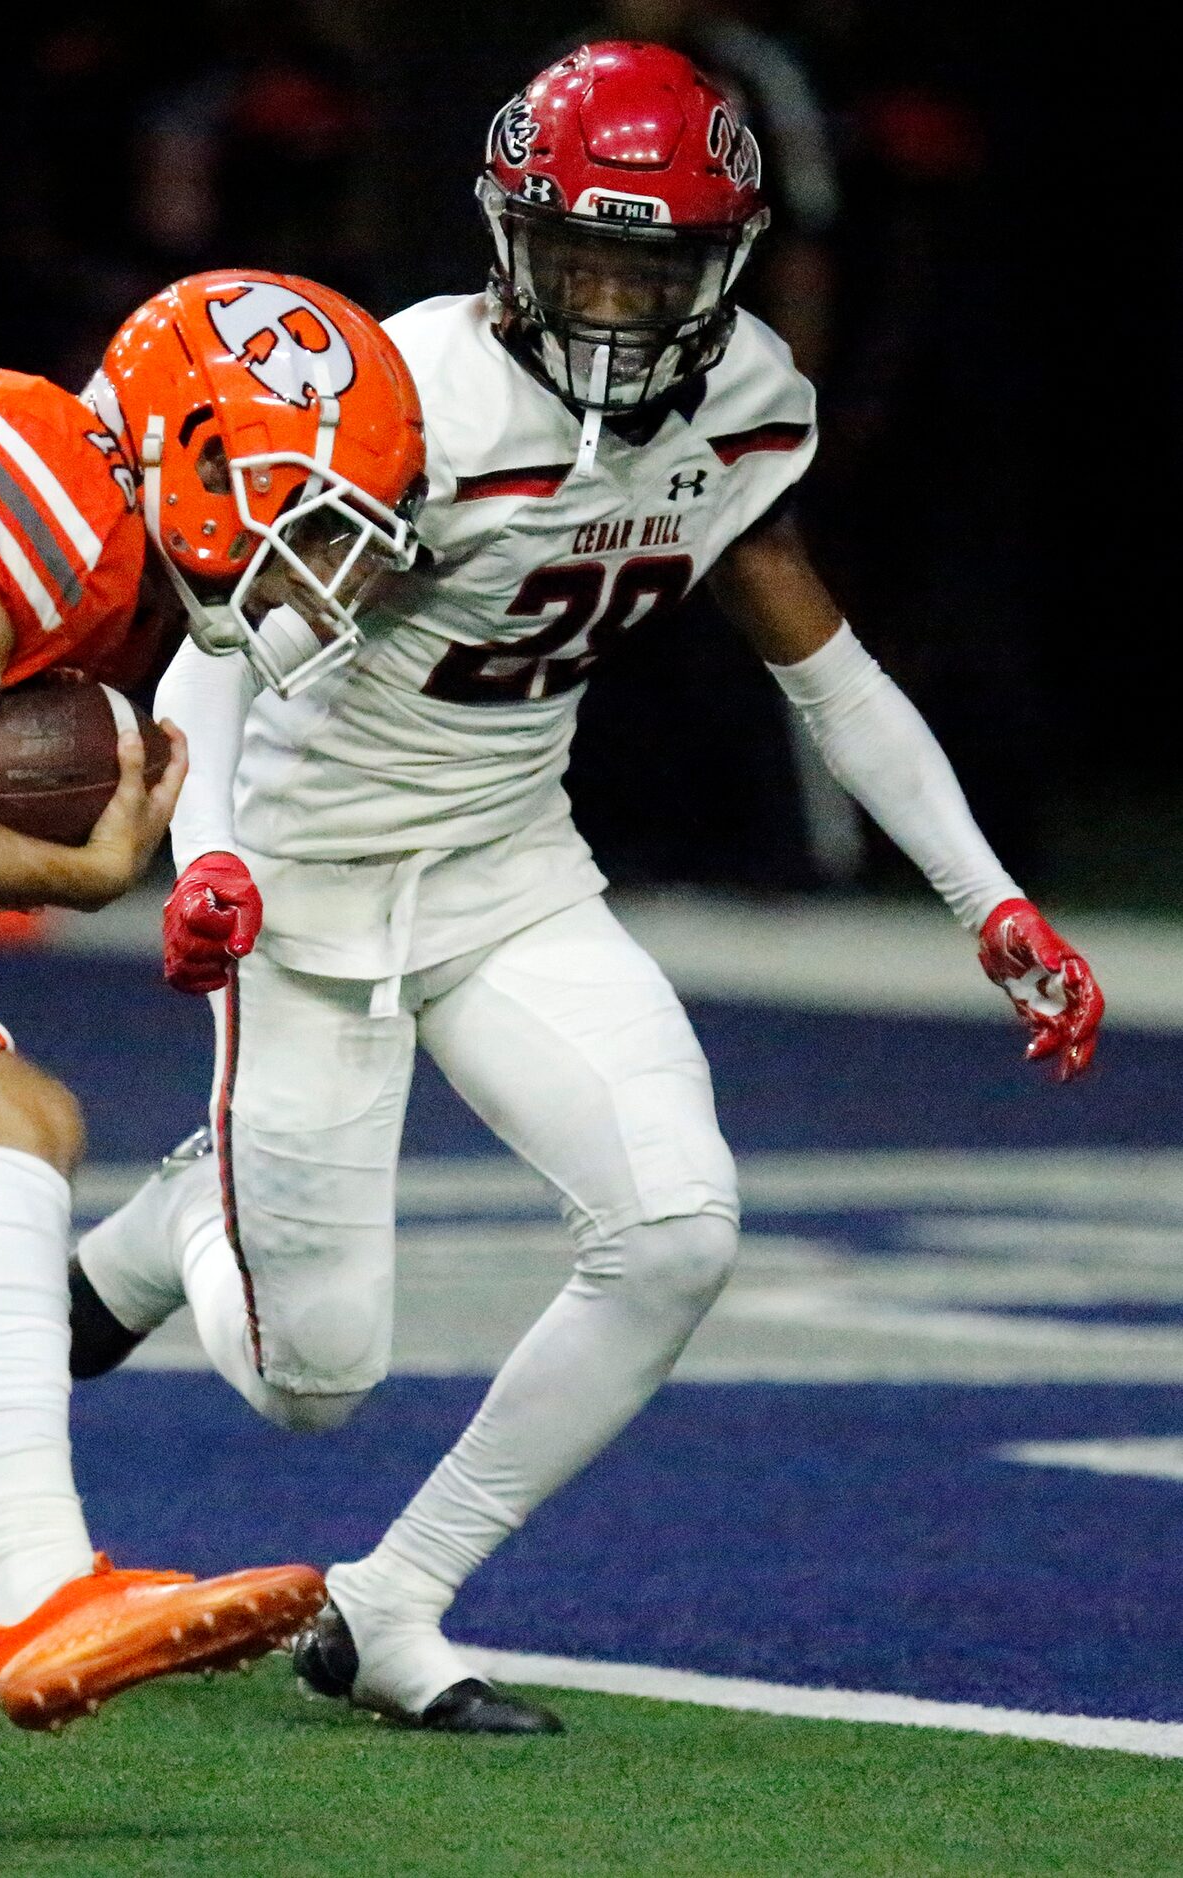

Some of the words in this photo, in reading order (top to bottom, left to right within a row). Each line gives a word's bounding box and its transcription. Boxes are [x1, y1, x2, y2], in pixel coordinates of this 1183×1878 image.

[599, 200, 651, 220] TTHL
[205, 280, 355, 410] R
[572, 519, 635, 555] CEDAR
[638, 514, 682, 547] HILL
